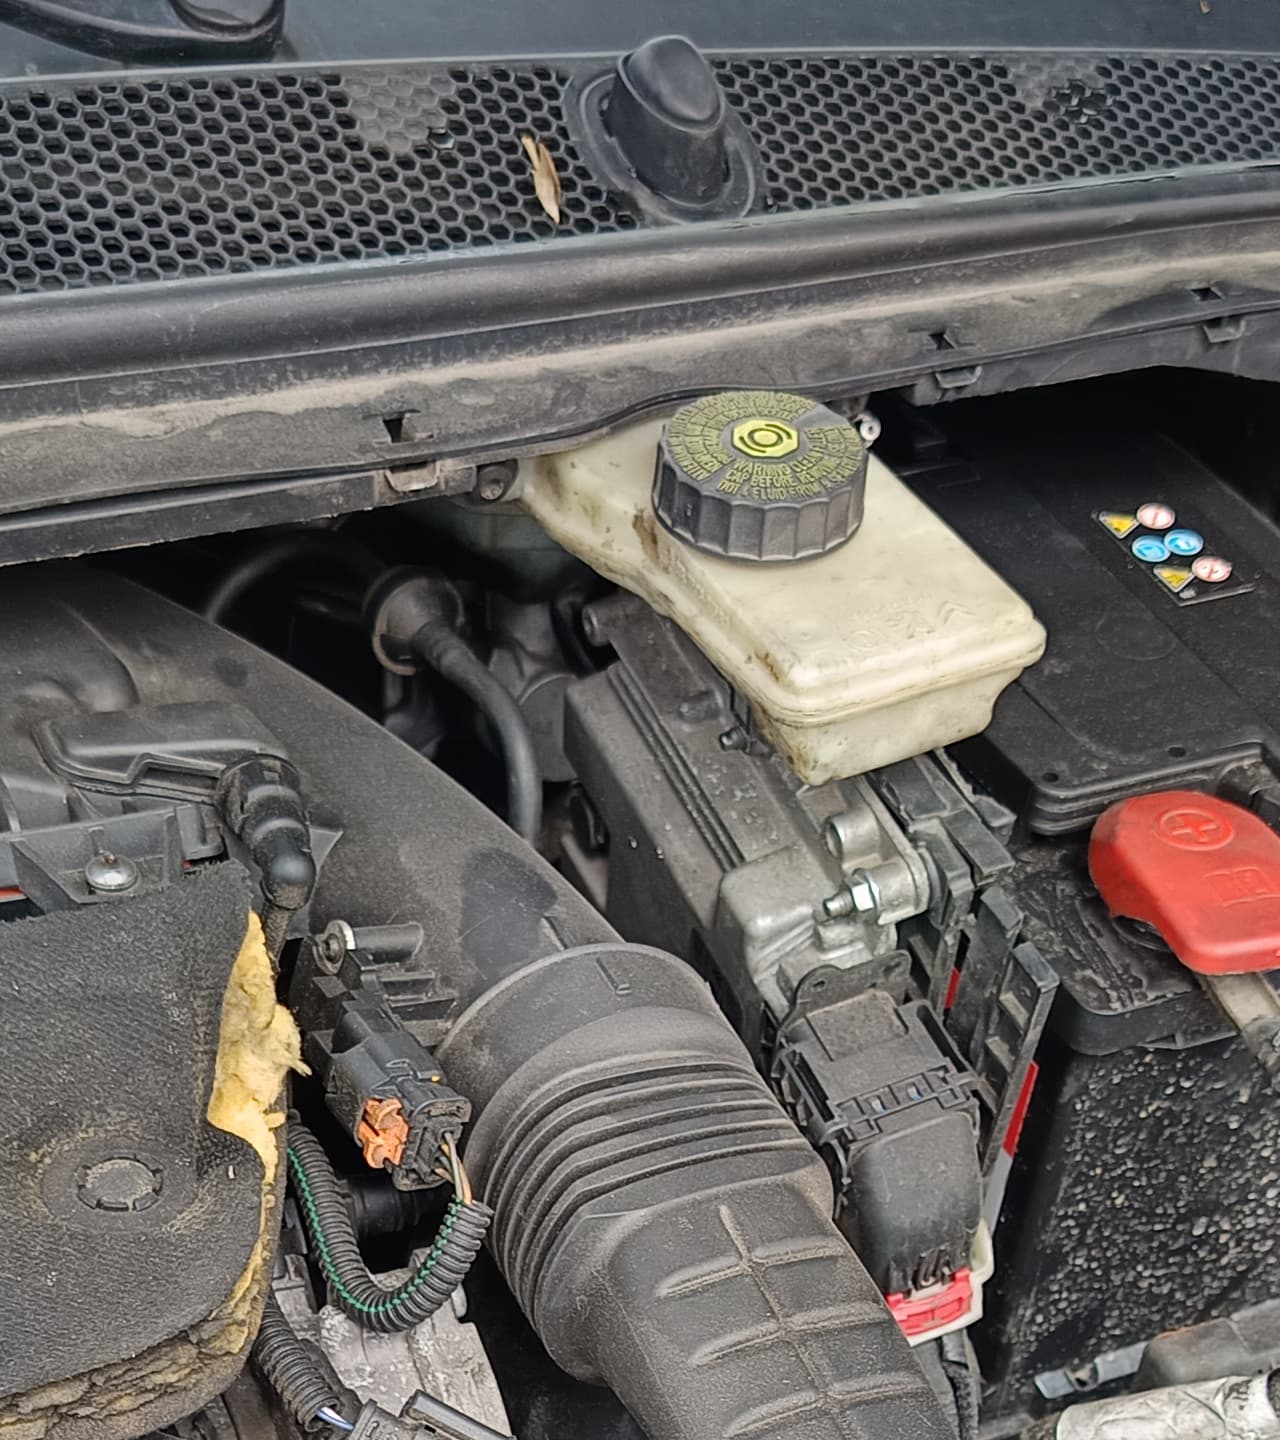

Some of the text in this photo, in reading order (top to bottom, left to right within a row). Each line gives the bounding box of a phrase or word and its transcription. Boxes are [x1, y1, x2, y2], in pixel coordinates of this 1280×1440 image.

[734, 460, 791, 476] WARNING
[725, 470, 750, 483] CAP
[751, 474, 798, 488] BEFORE
[717, 482, 740, 494] DOT
[752, 487, 787, 500] FLUID
[789, 481, 820, 497] FROM
